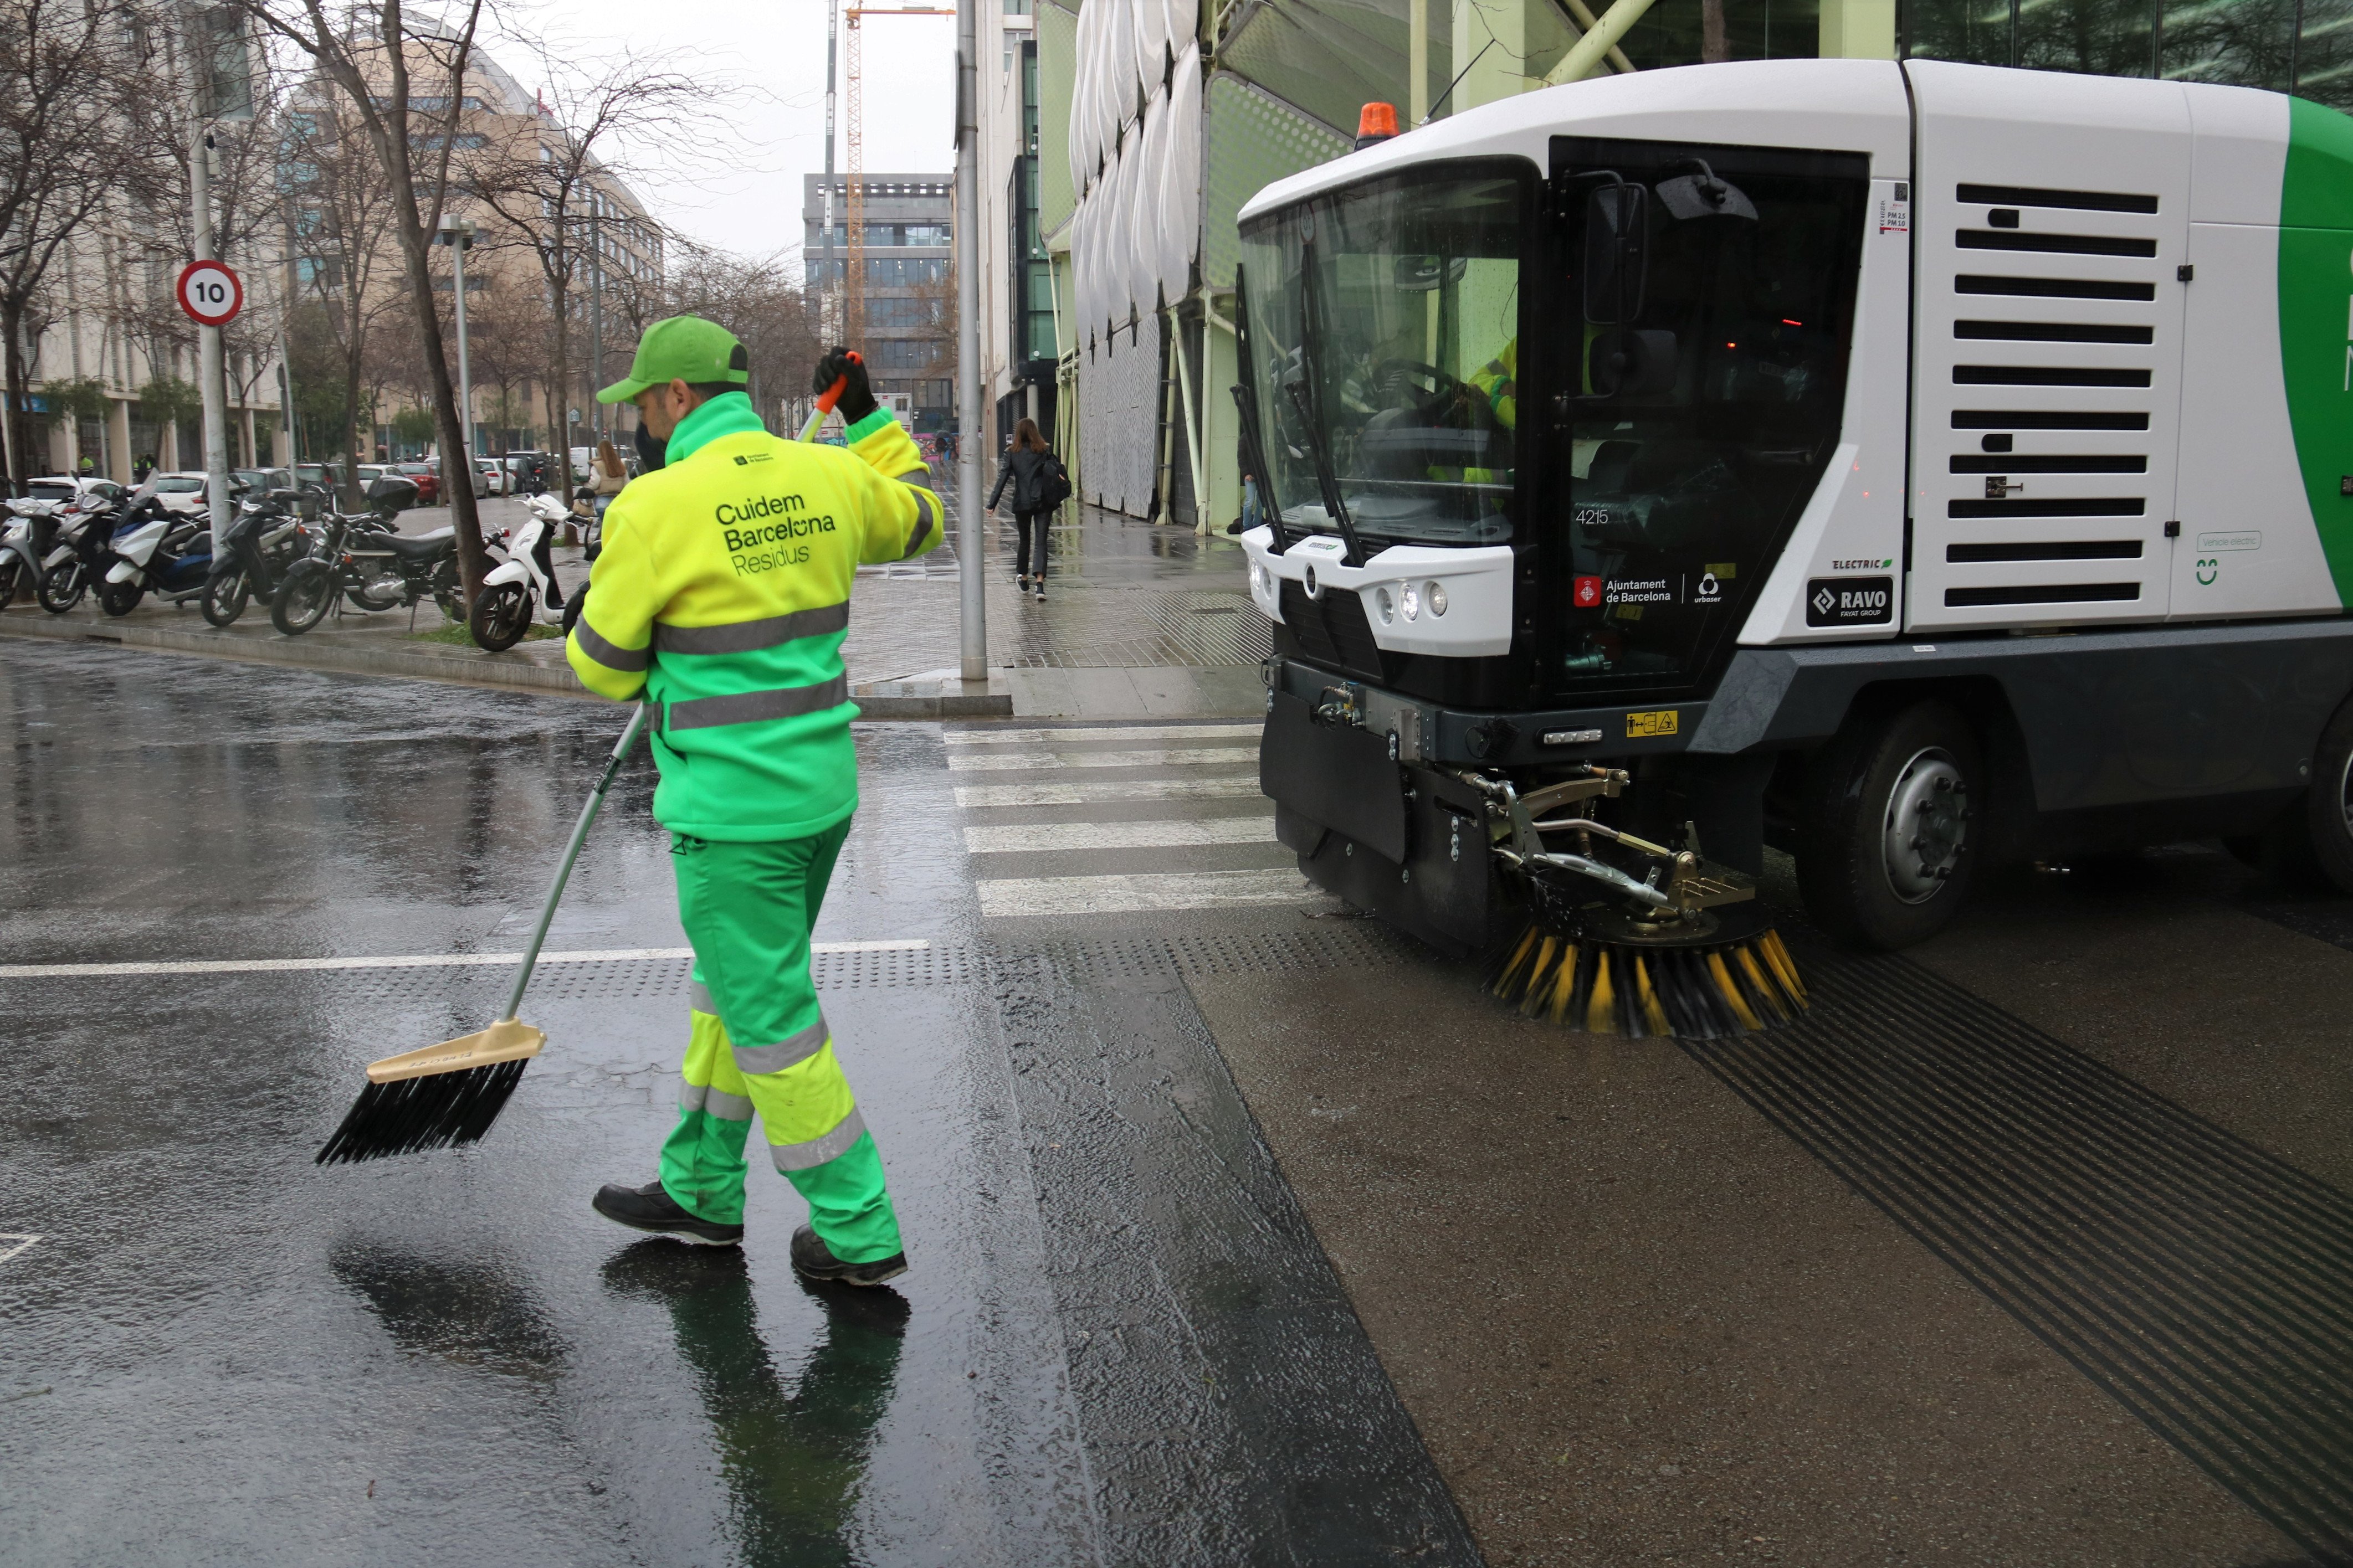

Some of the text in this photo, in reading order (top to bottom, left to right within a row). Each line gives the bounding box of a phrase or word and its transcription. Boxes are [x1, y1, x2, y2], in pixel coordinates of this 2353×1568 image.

[196, 282, 224, 303] 10
[715, 493, 805, 525] Cuidem
[1576, 510, 1608, 525] 4215
[723, 515, 835, 552] Barcelona
[731, 546, 809, 577] Residus
[1833, 559, 1880, 569] ELECTRIC
[1606, 579, 1665, 592] Ajuntament
[1606, 592, 1670, 603] de Barcelona
[1841, 590, 1886, 609] RAVO
